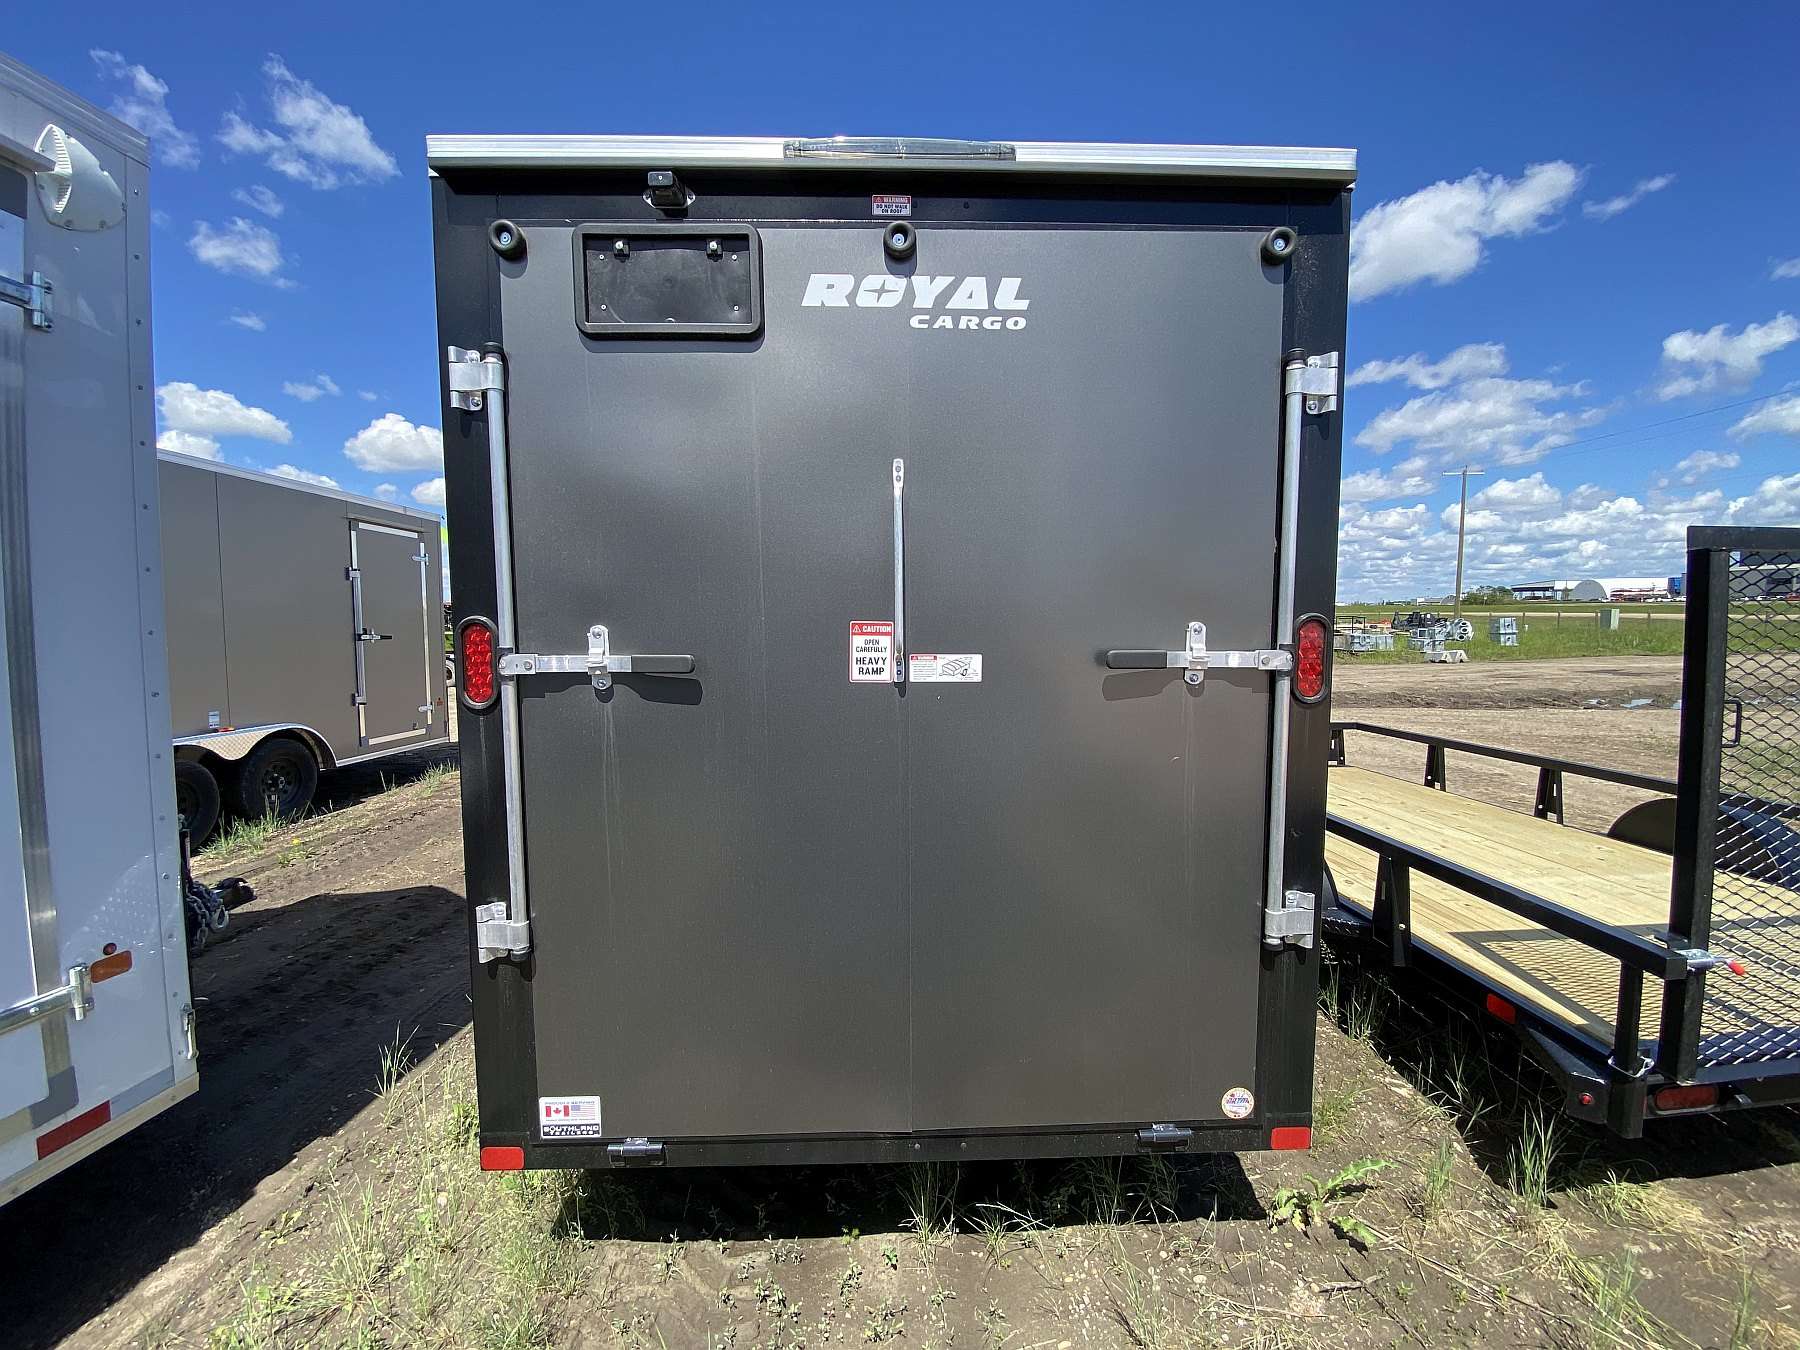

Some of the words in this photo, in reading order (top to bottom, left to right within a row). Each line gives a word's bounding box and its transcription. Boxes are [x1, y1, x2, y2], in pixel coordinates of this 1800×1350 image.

[801, 273, 1030, 311] ROYAL
[909, 315, 1027, 330] CARGO
[862, 625, 892, 633] CAUTION
[855, 657, 887, 665] HEAVY
[858, 667, 885, 675] RAMP
